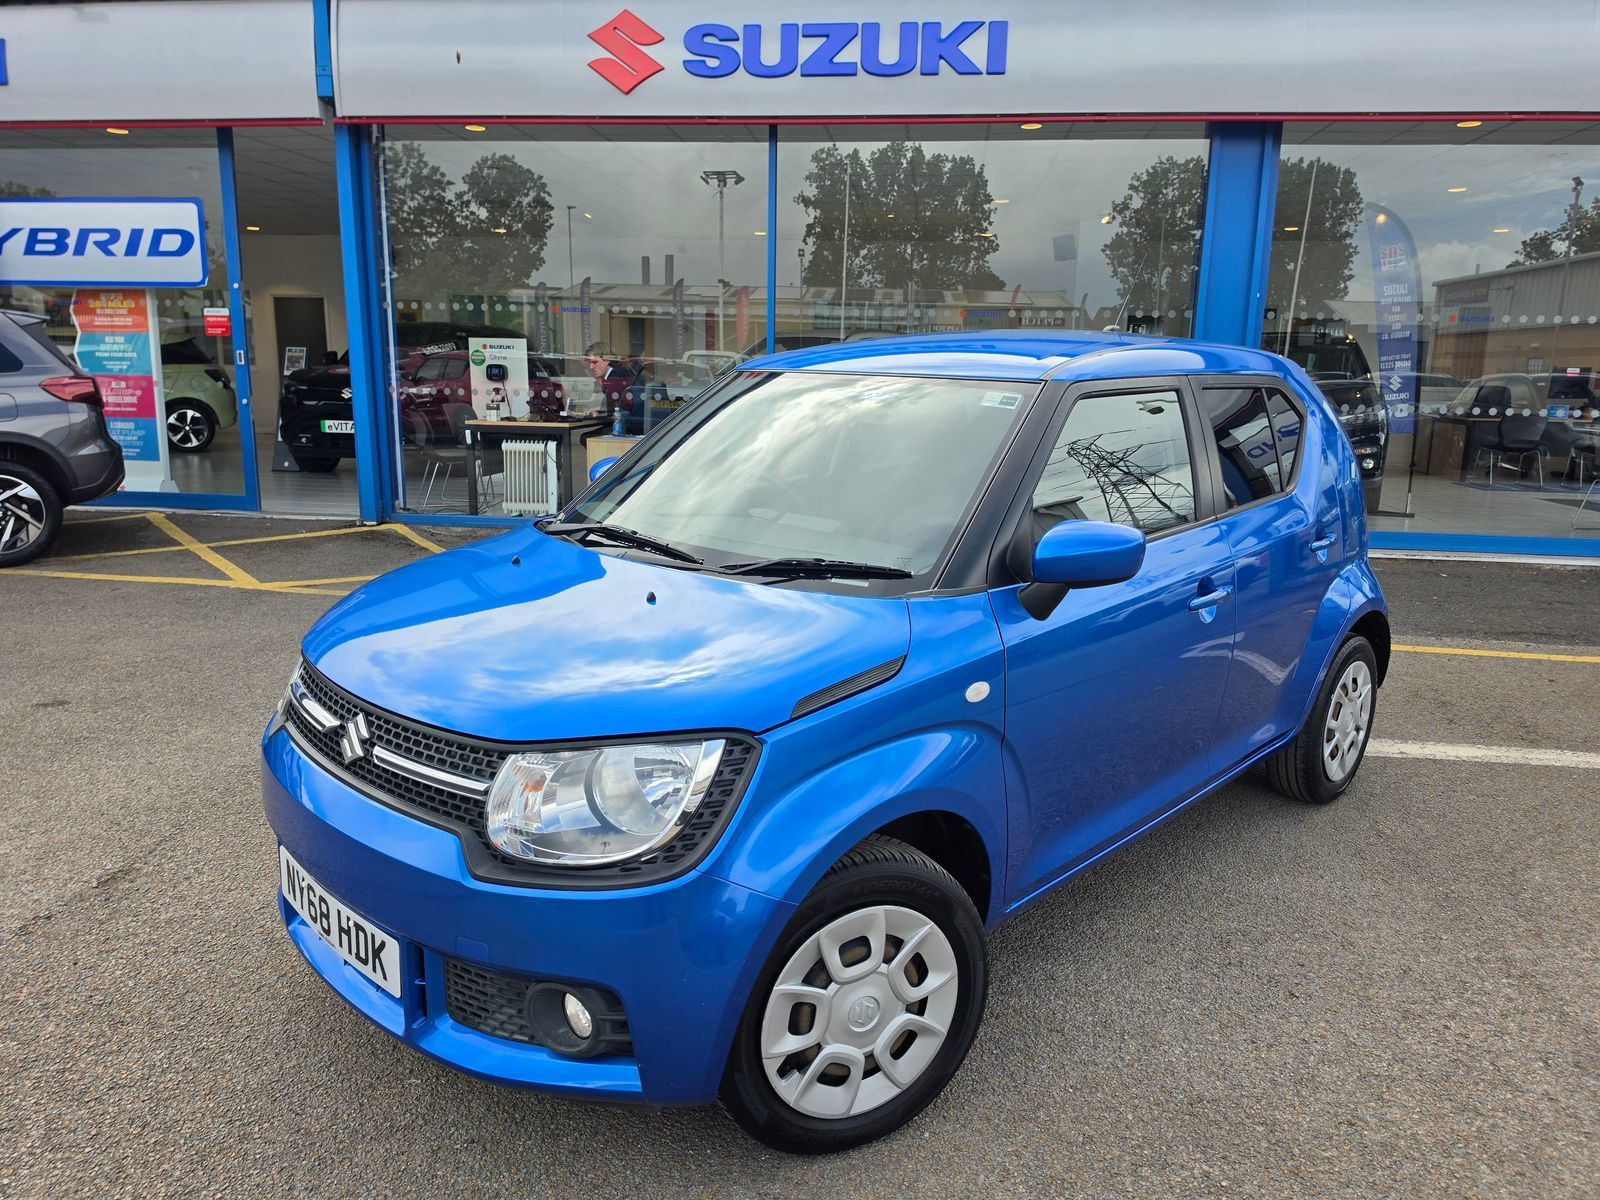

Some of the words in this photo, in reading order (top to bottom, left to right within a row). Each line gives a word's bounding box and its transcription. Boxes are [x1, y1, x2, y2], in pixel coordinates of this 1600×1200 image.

[683, 21, 1008, 78] SUZUKI
[1384, 284, 1408, 296] SUZUKI
[286, 858, 331, 937] NY68
[337, 908, 388, 981] HDK
